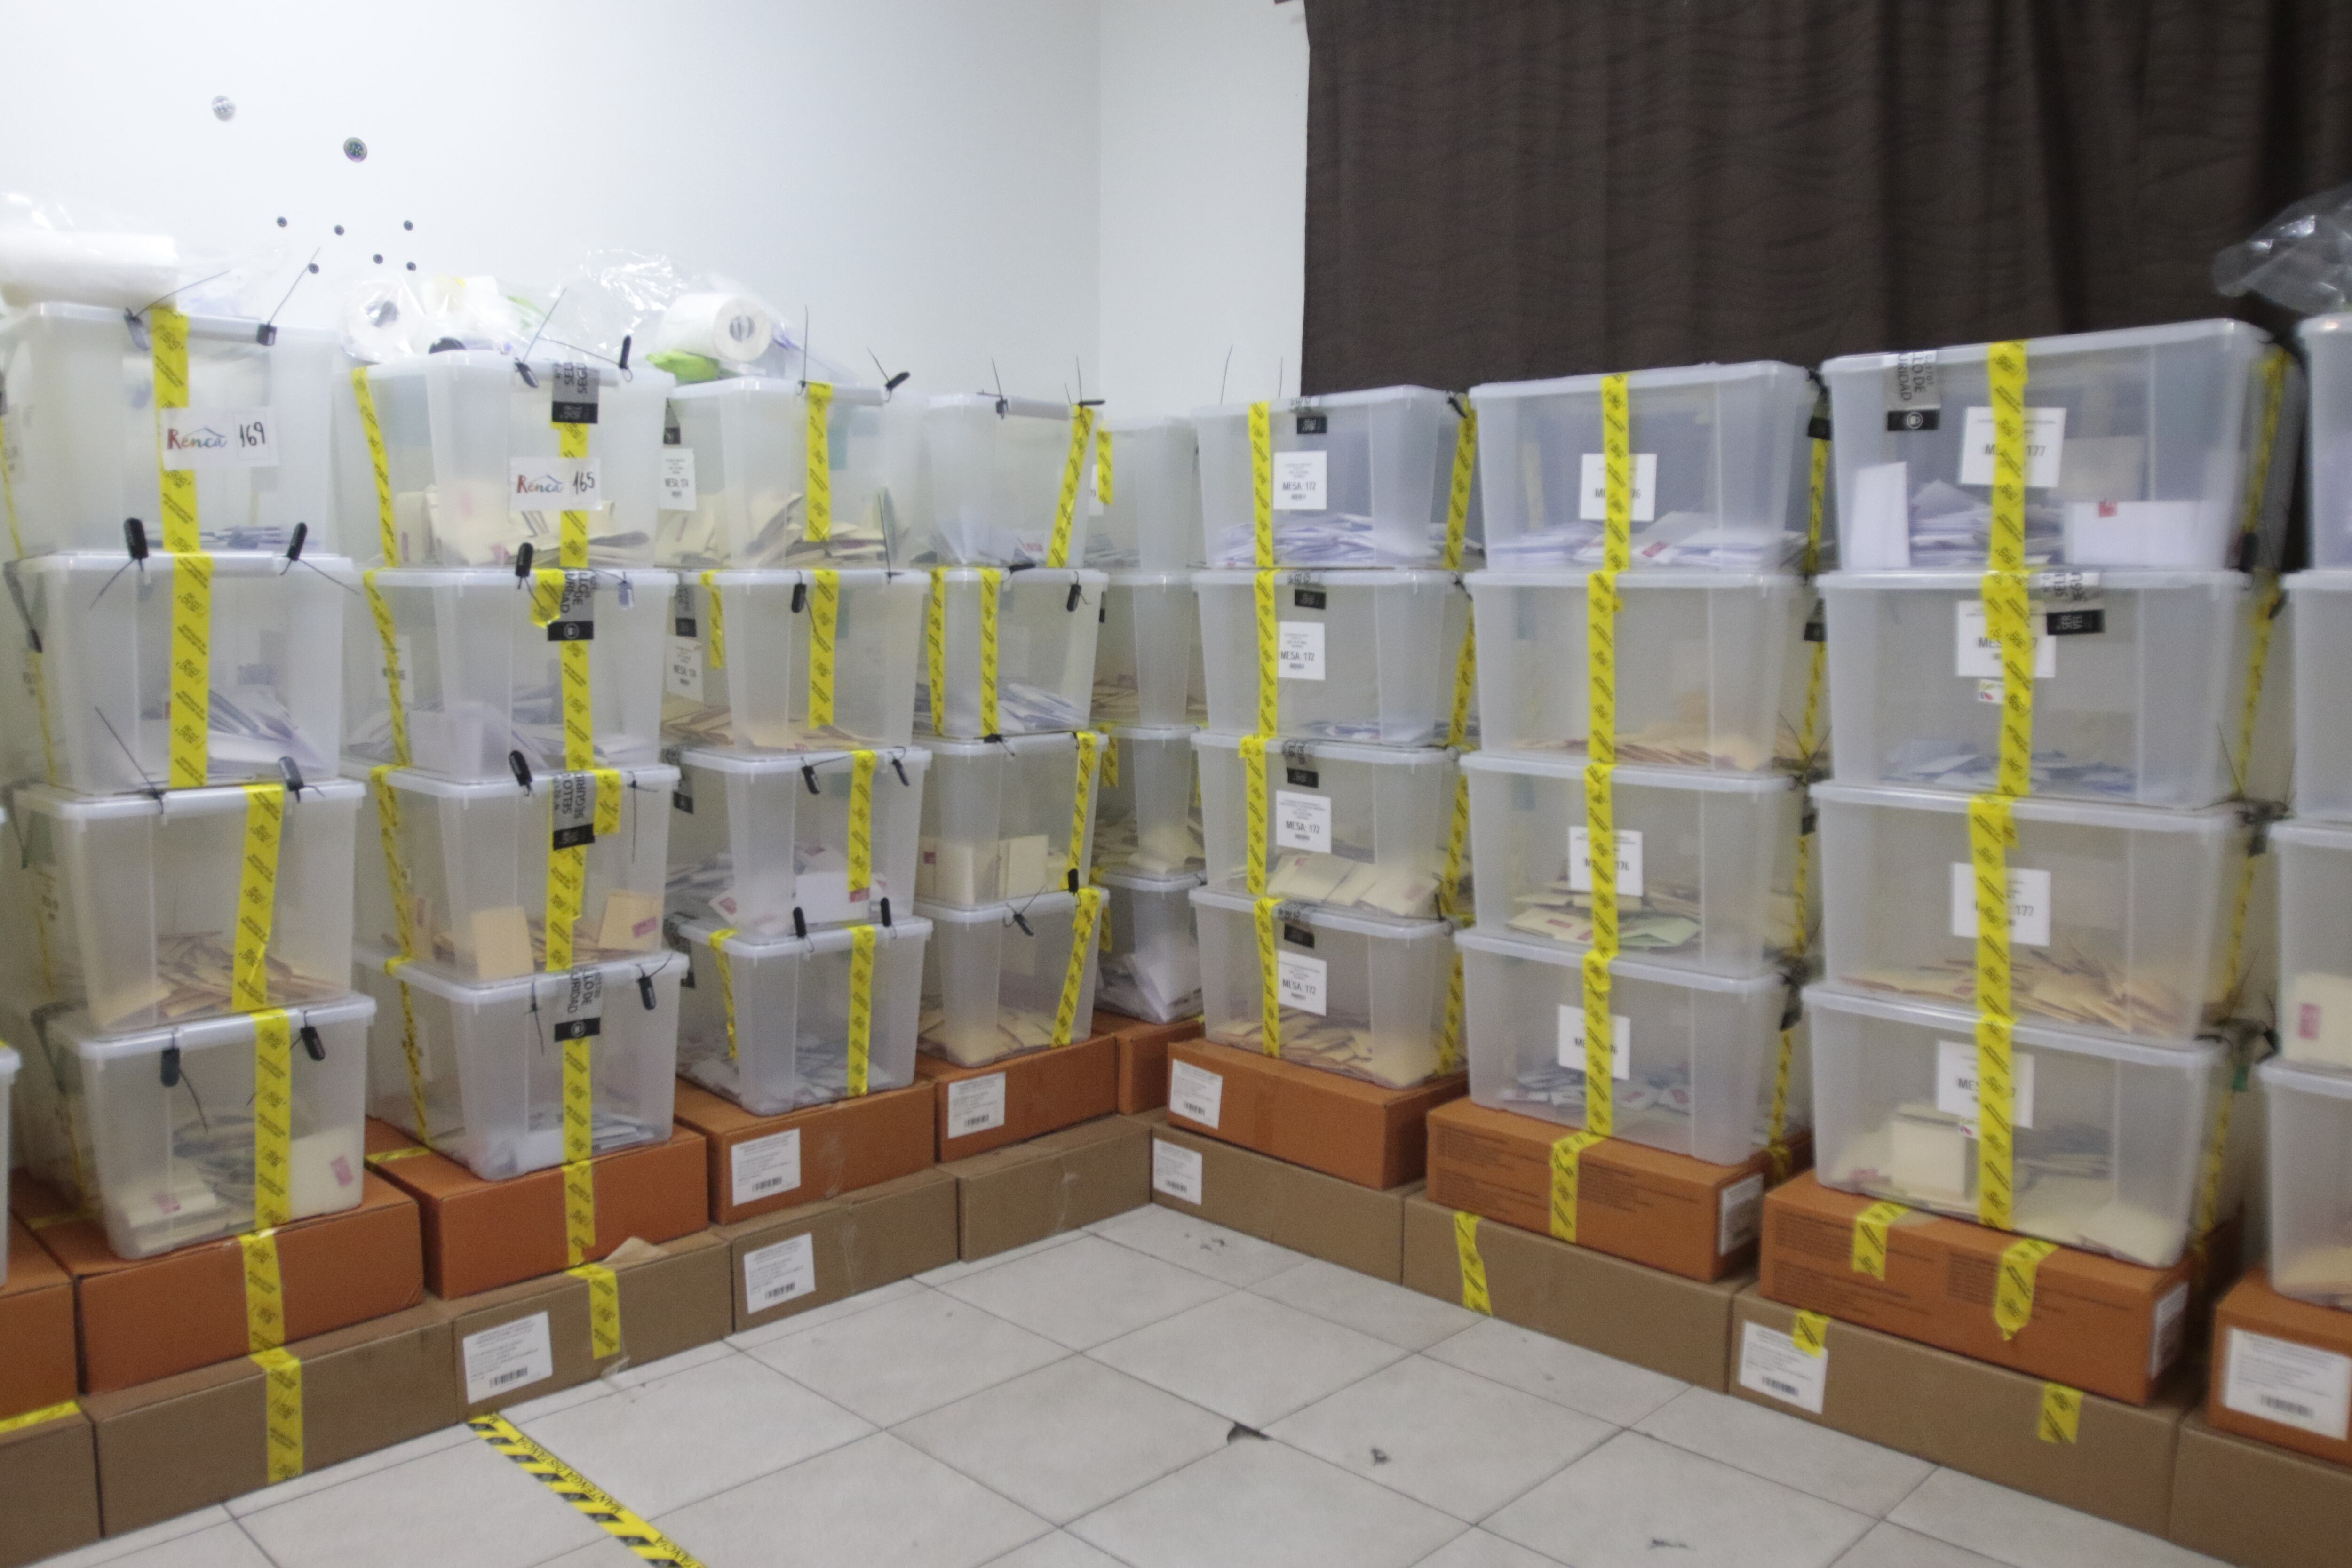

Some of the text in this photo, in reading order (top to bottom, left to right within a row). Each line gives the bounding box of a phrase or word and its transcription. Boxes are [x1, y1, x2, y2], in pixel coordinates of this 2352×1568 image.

[167, 422, 266, 450] Renca 169
[2026, 446, 2046, 457] 177
[516, 471, 595, 495] Renca 165
[1305, 481, 1317, 491] 172
[1630, 488, 1641, 499] 76
[1979, 637, 2002, 648] MES
[1304, 652, 1315, 661] 172
[562, 780, 573, 814] SELLO
[1309, 824, 1320, 834] 172
[2016, 905, 2035, 916] 177
[1305, 984, 1317, 995] 172
[1957, 1077, 1979, 1092] MES
[516, 1435, 626, 1514] MANTENGA DISTANCIA
